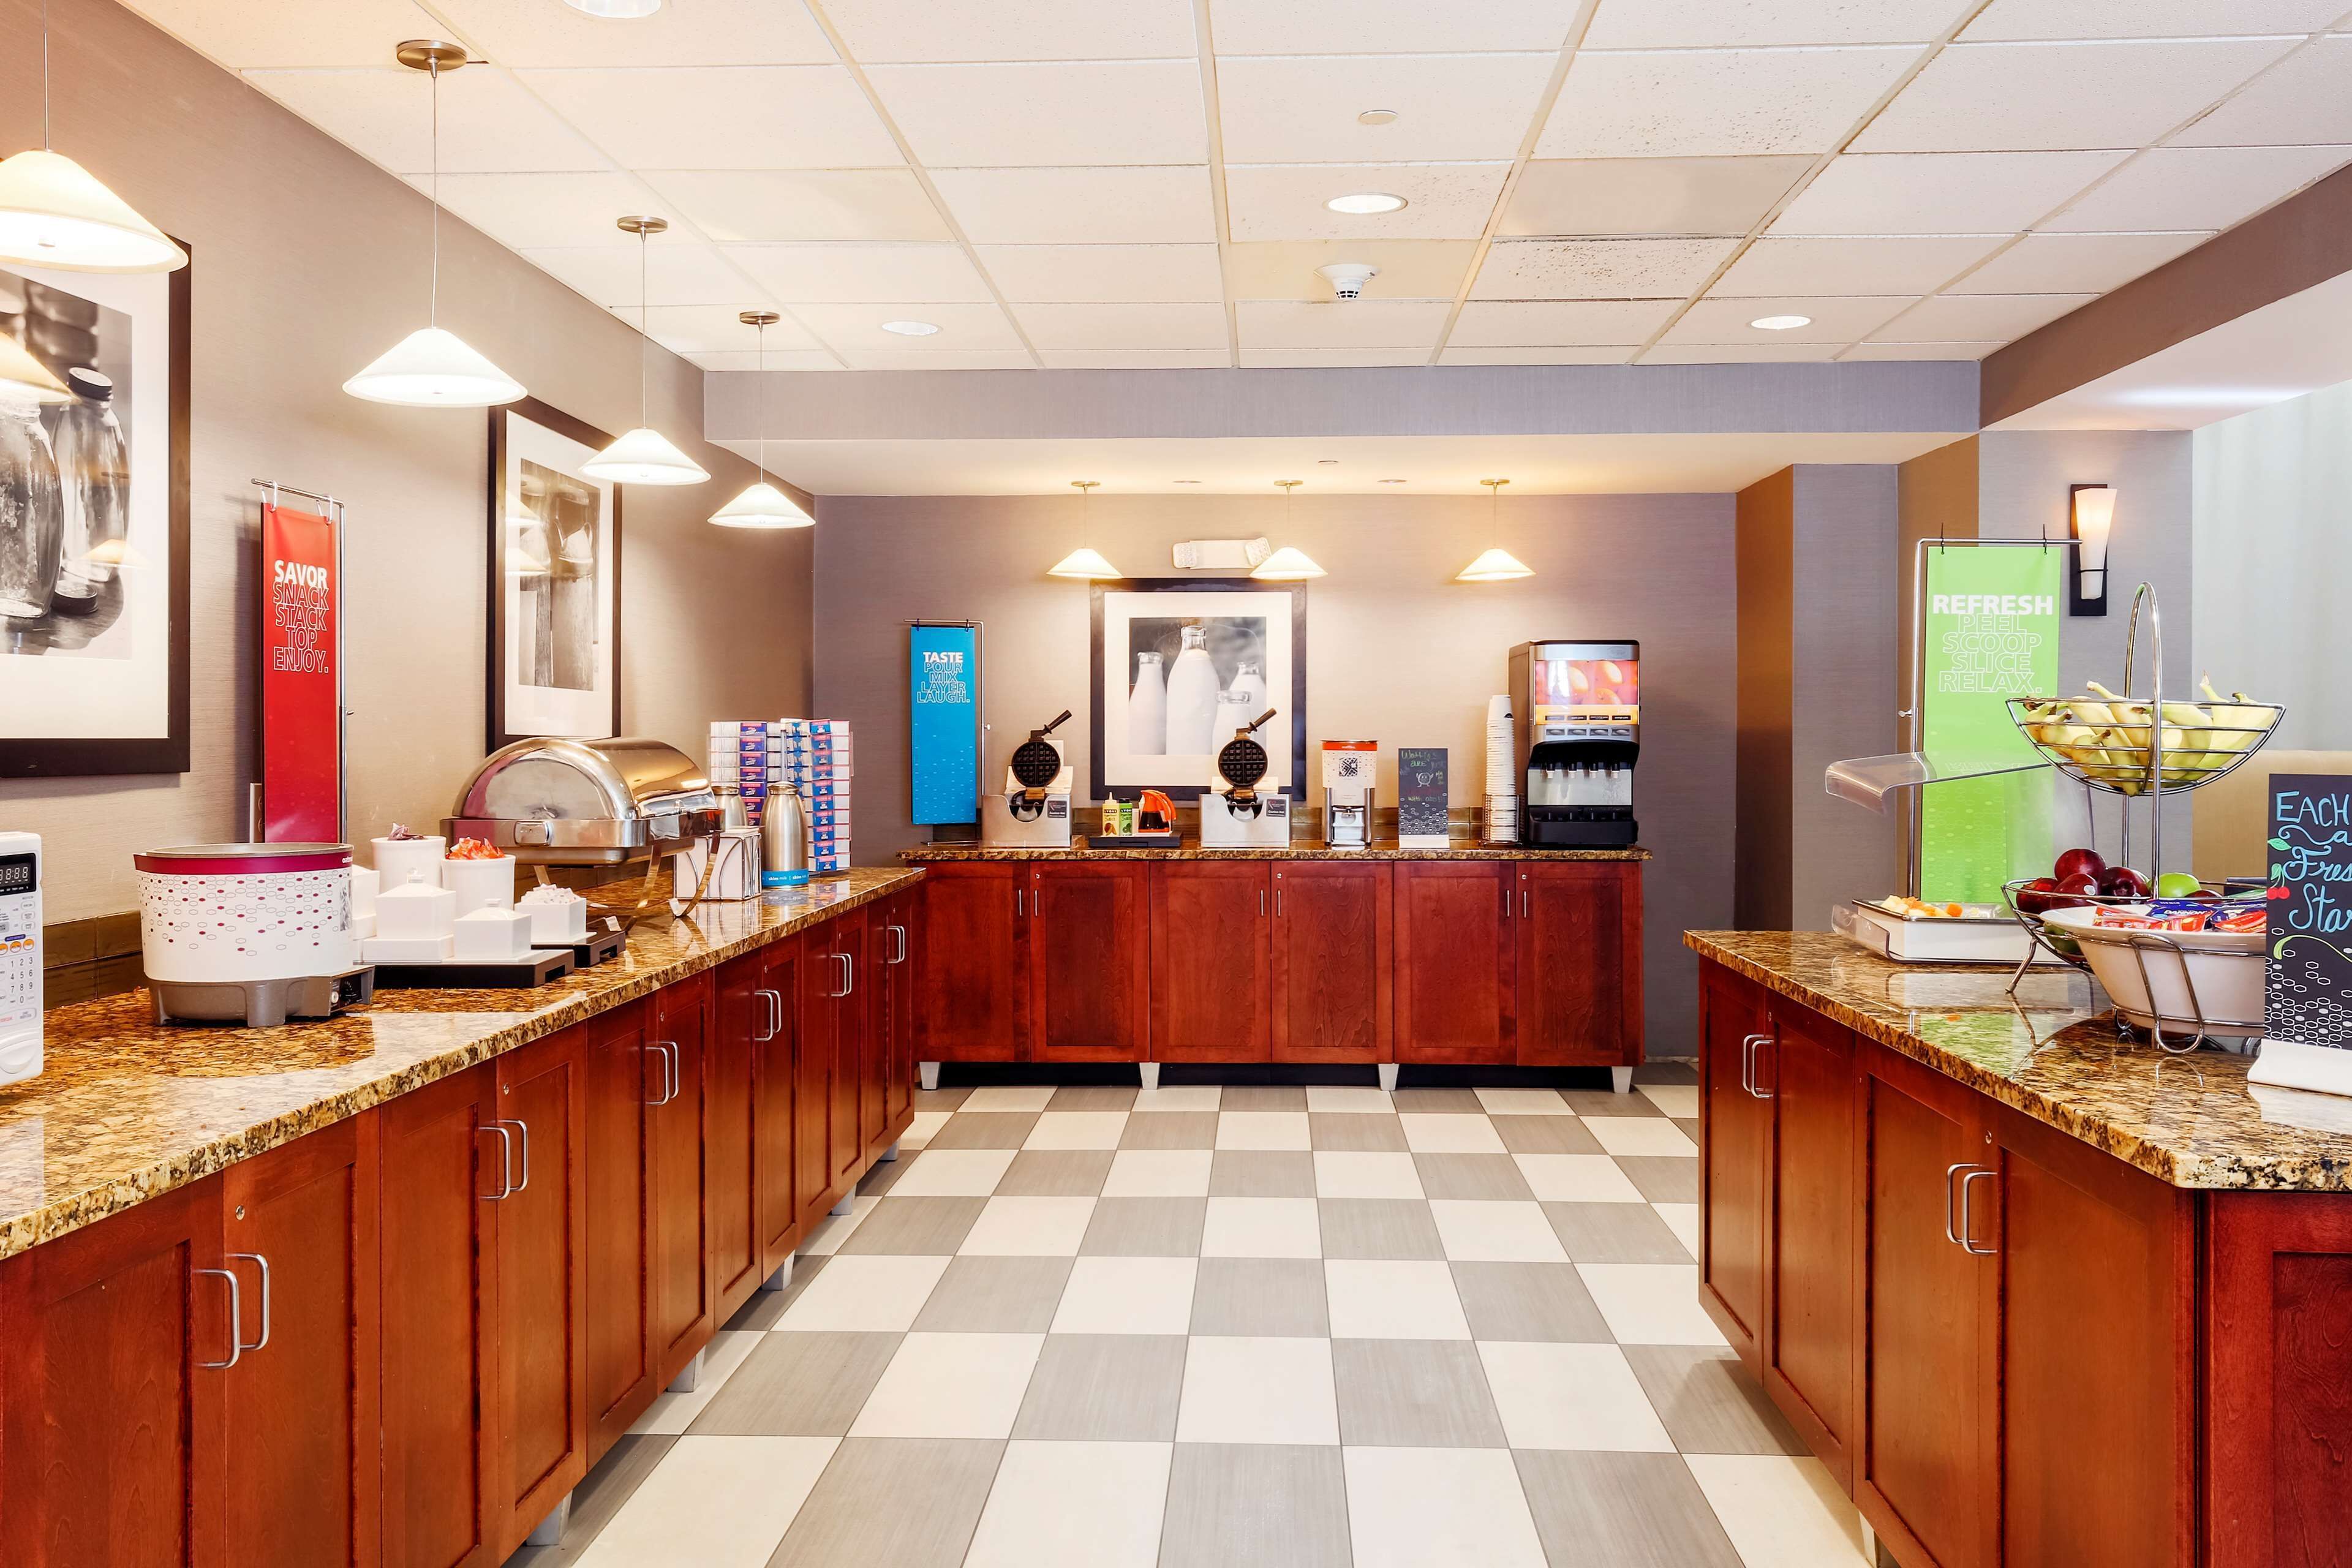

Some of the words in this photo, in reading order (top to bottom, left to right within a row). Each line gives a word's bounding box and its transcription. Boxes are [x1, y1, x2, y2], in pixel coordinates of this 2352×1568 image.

[274, 559, 328, 589] SAVOR
[273, 581, 329, 610] SNACK
[1932, 594, 2053, 616] REFRESH
[275, 603, 327, 631] STACK
[1958, 613, 2027, 635] PEEL
[285, 626, 317, 650] TOP
[1942, 632, 2042, 654] SCOOP
[273, 646, 329, 673] ENJOY.
[922, 652, 963, 663] TASTE
[924, 662, 963, 673] POUR
[1951, 652, 2031, 673] SLICE
[921, 681, 966, 693] LAYER
[929, 671, 957, 682] MIX
[1939, 671, 2043, 693] RELAX.
[917, 692, 970, 703] LAUGH.
[2276, 791, 2350, 827] EACH
